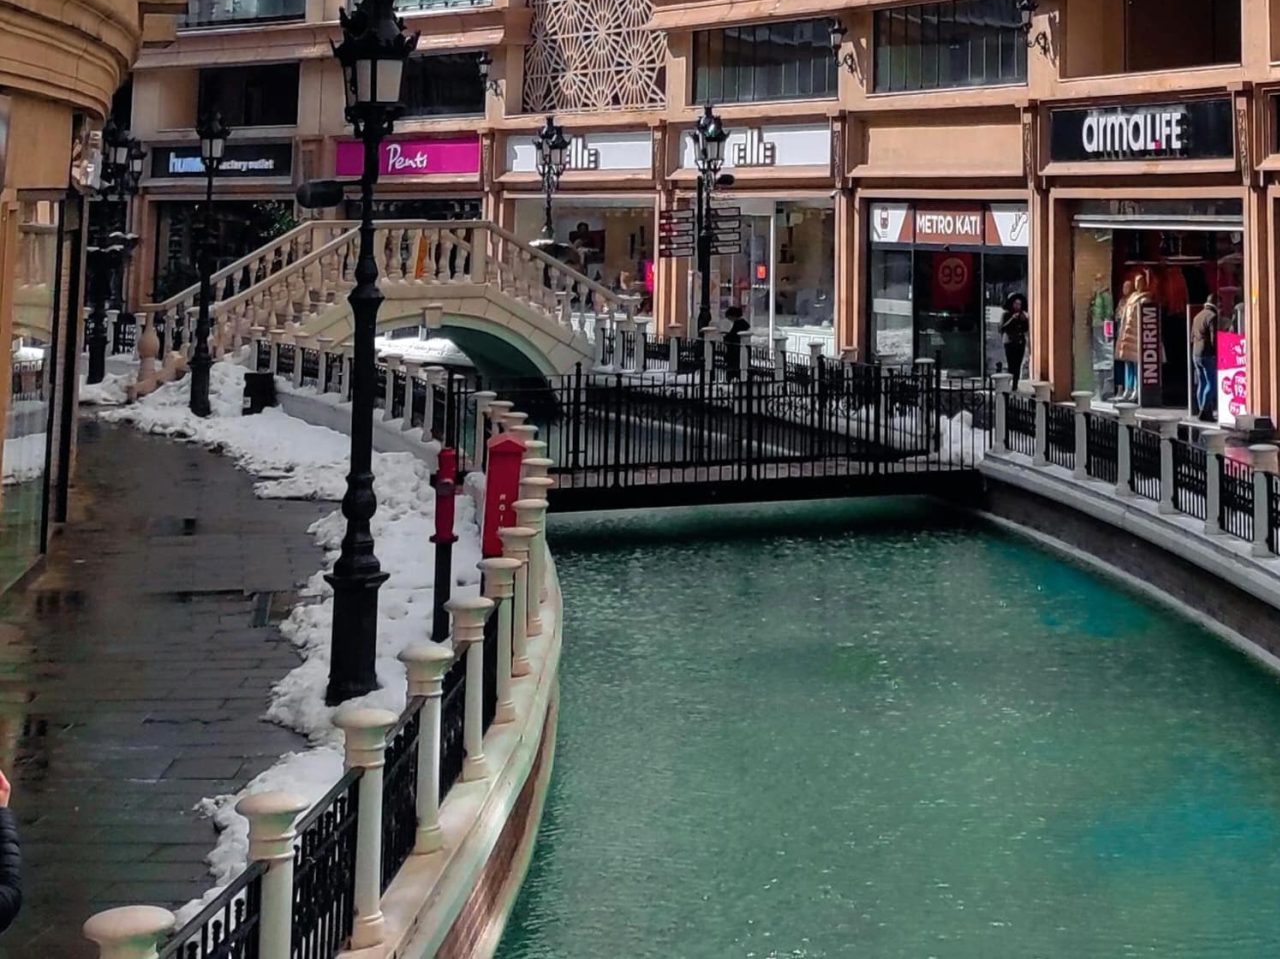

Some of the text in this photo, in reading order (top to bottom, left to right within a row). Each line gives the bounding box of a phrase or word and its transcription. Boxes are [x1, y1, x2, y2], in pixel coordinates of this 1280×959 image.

[386, 143, 428, 173] Penti
[916, 214, 981, 235] METRO KATI
